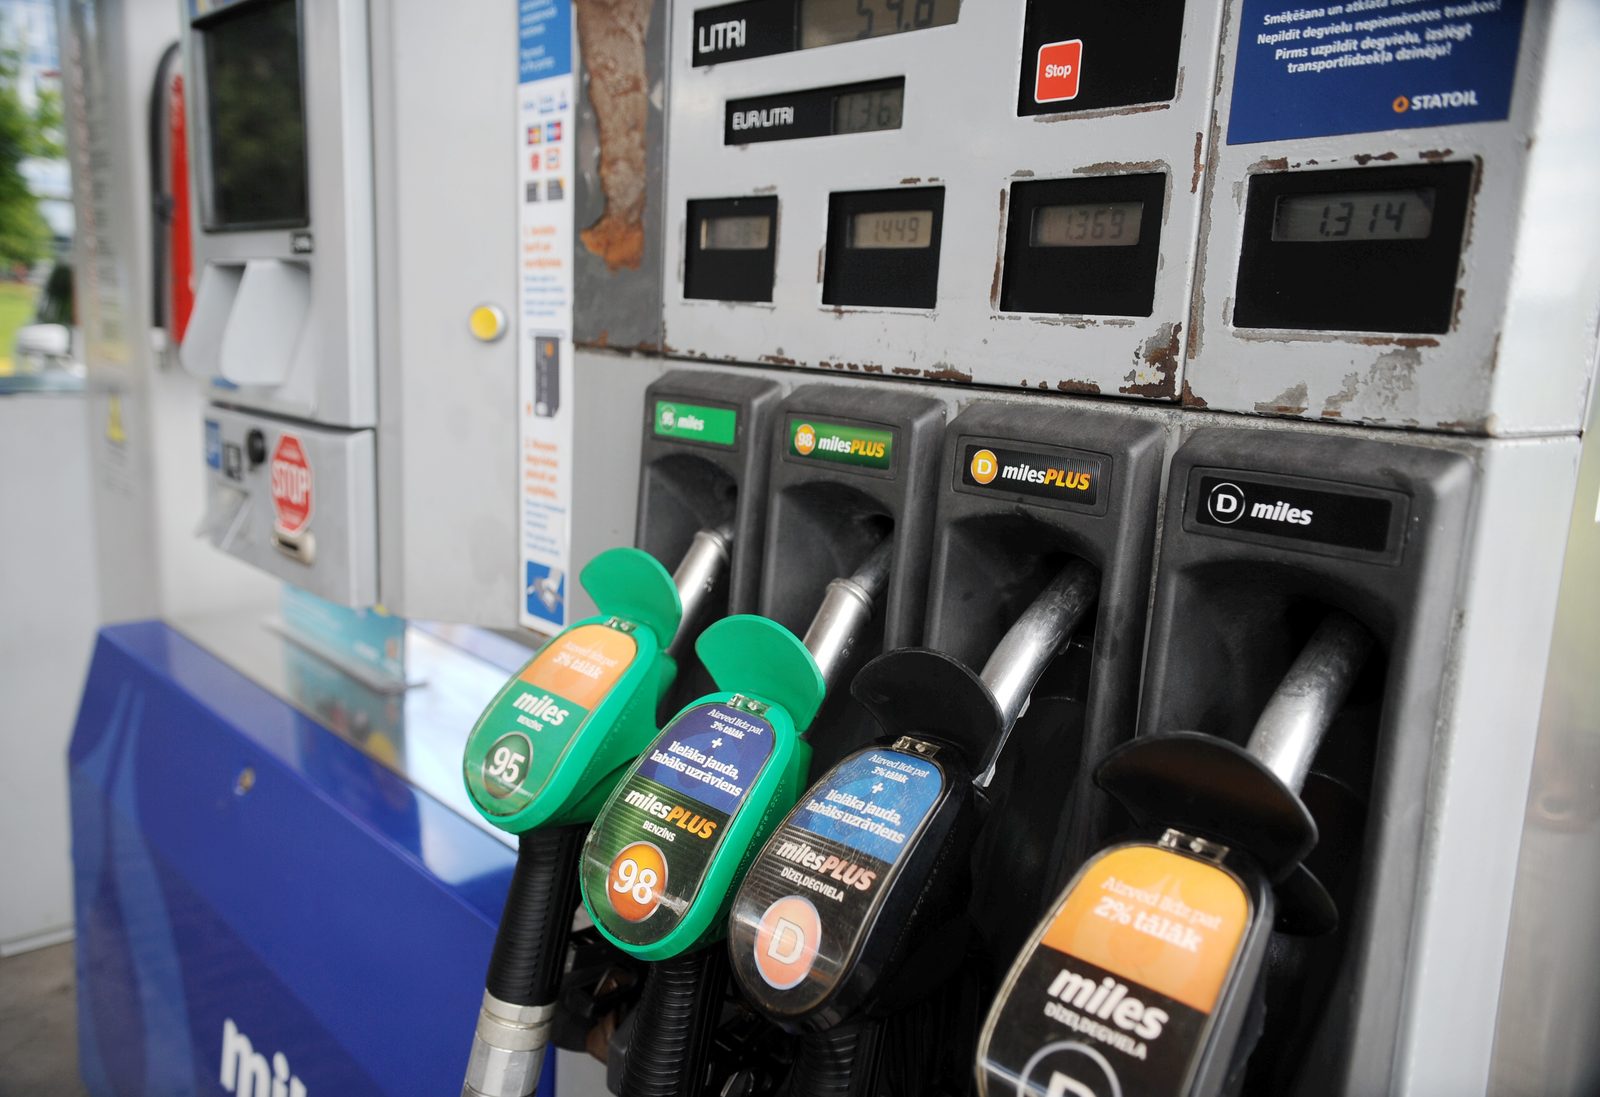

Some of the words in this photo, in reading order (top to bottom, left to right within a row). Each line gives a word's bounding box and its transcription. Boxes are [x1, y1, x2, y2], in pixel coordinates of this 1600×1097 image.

[1327, 5, 1343, 16] un
[698, 19, 747, 53] LITRI
[1257, 29, 1301, 45] Nepildīt
[1302, 21, 1353, 39] degvielu
[1275, 48, 1308, 60] Pirms
[1310, 40, 1358, 57] uzpildīt
[1045, 64, 1072, 79] Stop
[1410, 90, 1478, 110] STATOIL
[732, 106, 794, 130] EUR/LITRI
[677, 414, 705, 432] miles
[797, 431, 813, 447] 98
[818, 435, 885, 458] milesPLUS
[272, 460, 312, 505] STOP
[977, 459, 993, 475] D
[1001, 464, 1091, 491] milesPLUS
[1215, 493, 1238, 513] D
[1250, 500, 1314, 526] miles
[512, 692, 570, 726] miles
[707, 708, 738, 725] Aizved
[747, 725, 764, 736] pat
[710, 721, 726, 731] 3%
[488, 746, 526, 783] 95
[650, 750, 688, 773] labāks
[684, 765, 743, 798] uzrāviens
[668, 741, 706, 765] lielāka
[703, 756, 740, 780] jauda,
[868, 754, 901, 768] Aizved
[911, 770, 931, 779] pat
[871, 766, 887, 777] 3%
[624, 789, 718, 841] milesPLUS
[805, 799, 845, 821] labāks
[841, 813, 906, 844] uzrāviens
[825, 789, 866, 811] lielāka
[861, 801, 902, 827] jauda,
[612, 858, 659, 906] 98
[776, 841, 878, 892] milesPLUS
[1093, 895, 1135, 926] 2%
[767, 917, 806, 966] D
[1046, 968, 1170, 1040] miles
